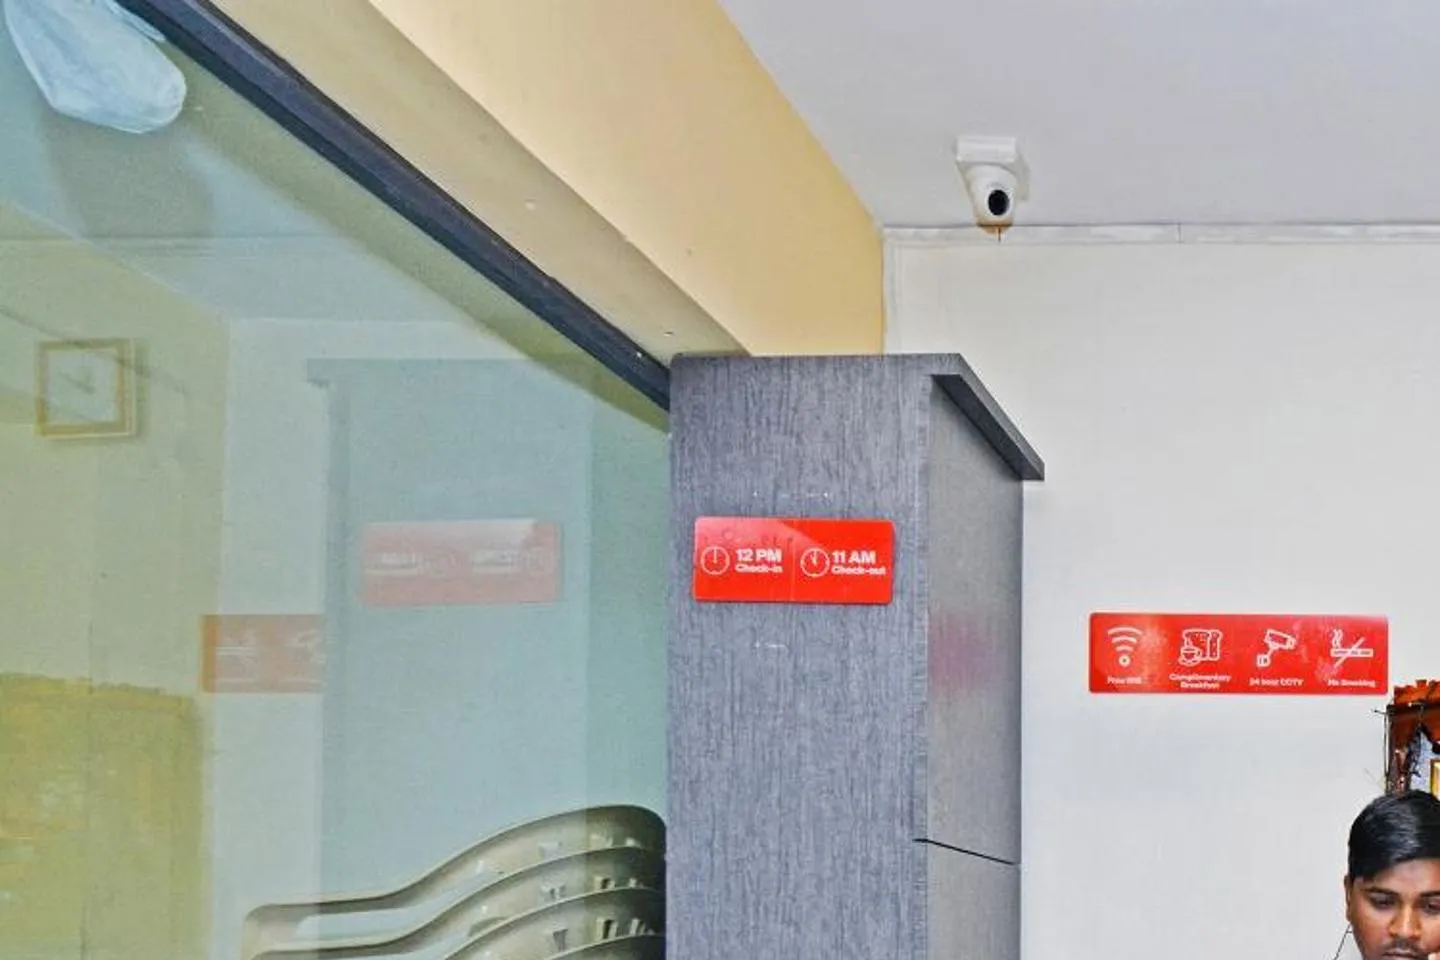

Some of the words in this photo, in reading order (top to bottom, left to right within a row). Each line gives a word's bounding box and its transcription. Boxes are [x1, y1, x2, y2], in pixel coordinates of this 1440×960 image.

[735, 548, 754, 562] 12
[755, 548, 783, 562] PM
[832, 549, 847, 564] 11
[847, 549, 877, 565] AM
[735, 564, 784, 573] Check-in
[831, 565, 887, 576] Check-out
[1168, 673, 1232, 683] Complimentary
[1279, 677, 1304, 688] CCTV
